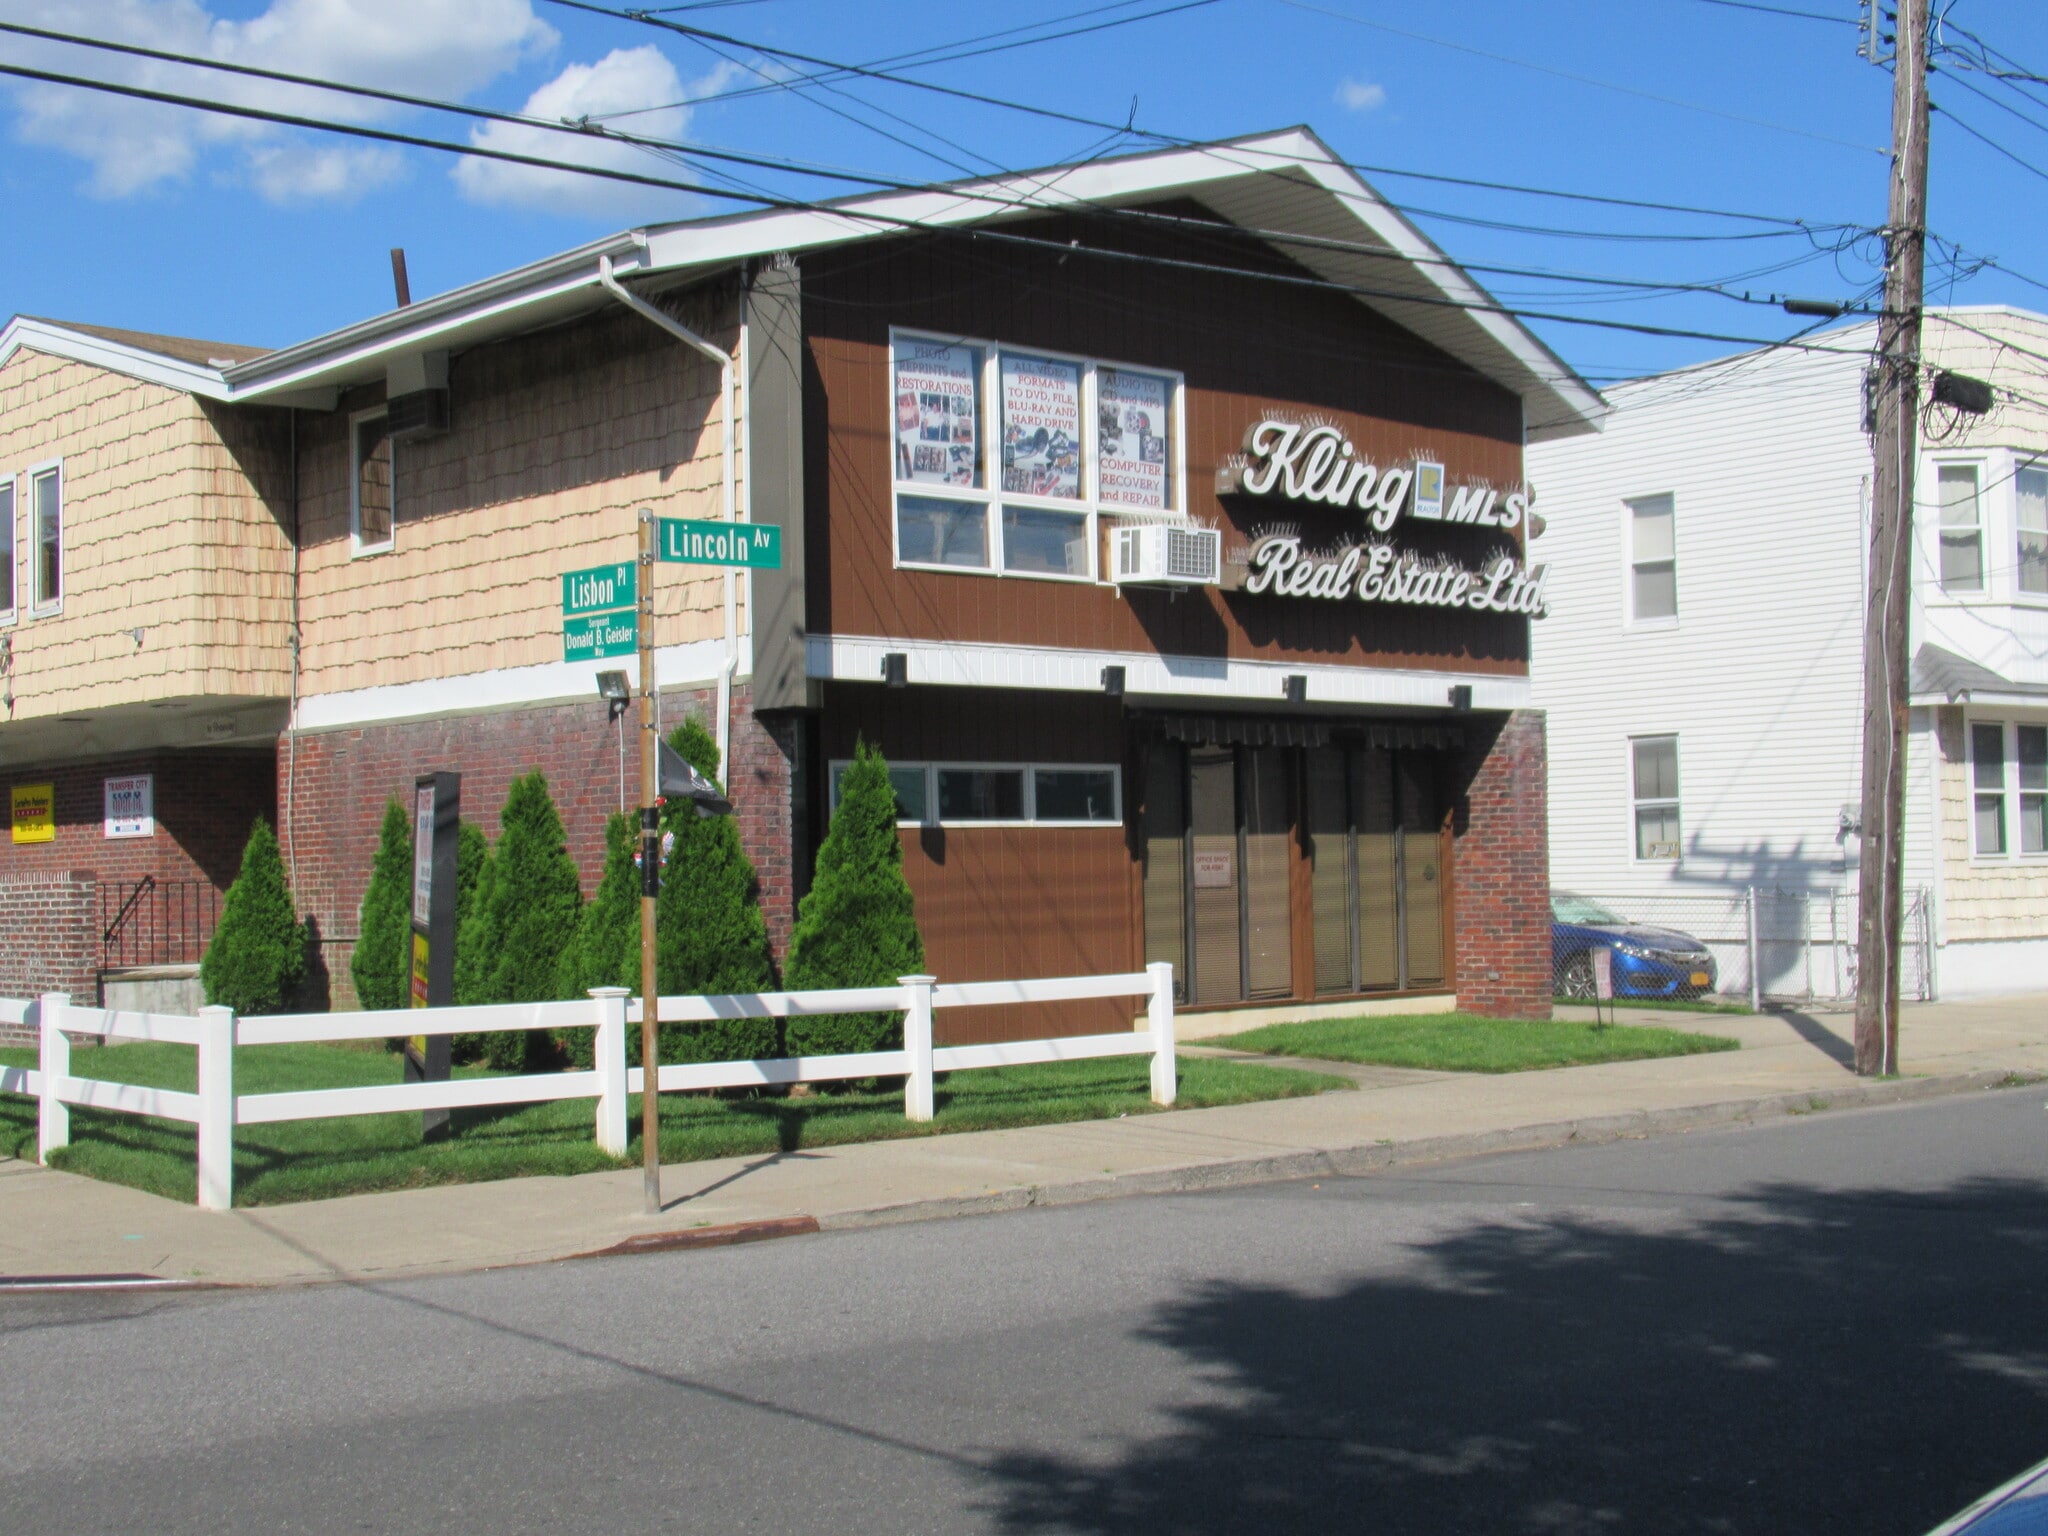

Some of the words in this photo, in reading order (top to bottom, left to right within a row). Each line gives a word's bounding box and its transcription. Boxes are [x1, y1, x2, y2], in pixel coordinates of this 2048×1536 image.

[914, 346, 951, 361] PHOTO
[898, 360, 948, 377] REPRINTS
[950, 367, 968, 379] and
[1013, 361, 1034, 373] ALL
[1037, 364, 1068, 378] VIDEO
[896, 376, 973, 396] RESTORATIONS
[1018, 374, 1066, 391] FORMATS
[1105, 373, 1140, 390] AUDIO
[1143, 382, 1156, 393] TO
[1008, 387, 1023, 398] TO
[1025, 389, 1051, 402] DVD,
[1053, 393, 1076, 406] FILE,
[1101, 389, 1118, 401] CD
[1120, 395, 1137, 404] and
[1140, 396, 1160, 409] MP3
[1008, 400, 1052, 415] BLU-RAY
[1055, 407, 1077, 418] AND
[1011, 414, 1042, 426] HARD
[1044, 418, 1074, 430] DRIVE
[1100, 457, 1161, 476] COMPUTER
[1243, 420, 1414, 532] Kling
[1101, 473, 1160, 491] RECOVERY
[1100, 489, 1119, 501] and
[1122, 491, 1160, 506] REPAIR
[1446, 486, 1526, 528] MLS
[669, 523, 749, 561] Lincoln
[754, 528, 770, 548] Av
[1246, 537, 1361, 600] Real
[1359, 545, 1470, 607] Estate
[1469, 558, 1551, 616] Ltd.
[571, 573, 614, 609] Lisbon
[617, 567, 626, 587] Pl
[566, 629, 594, 649] Donald
[596, 628, 605, 646] B.
[606, 625, 633, 645] Geisler
